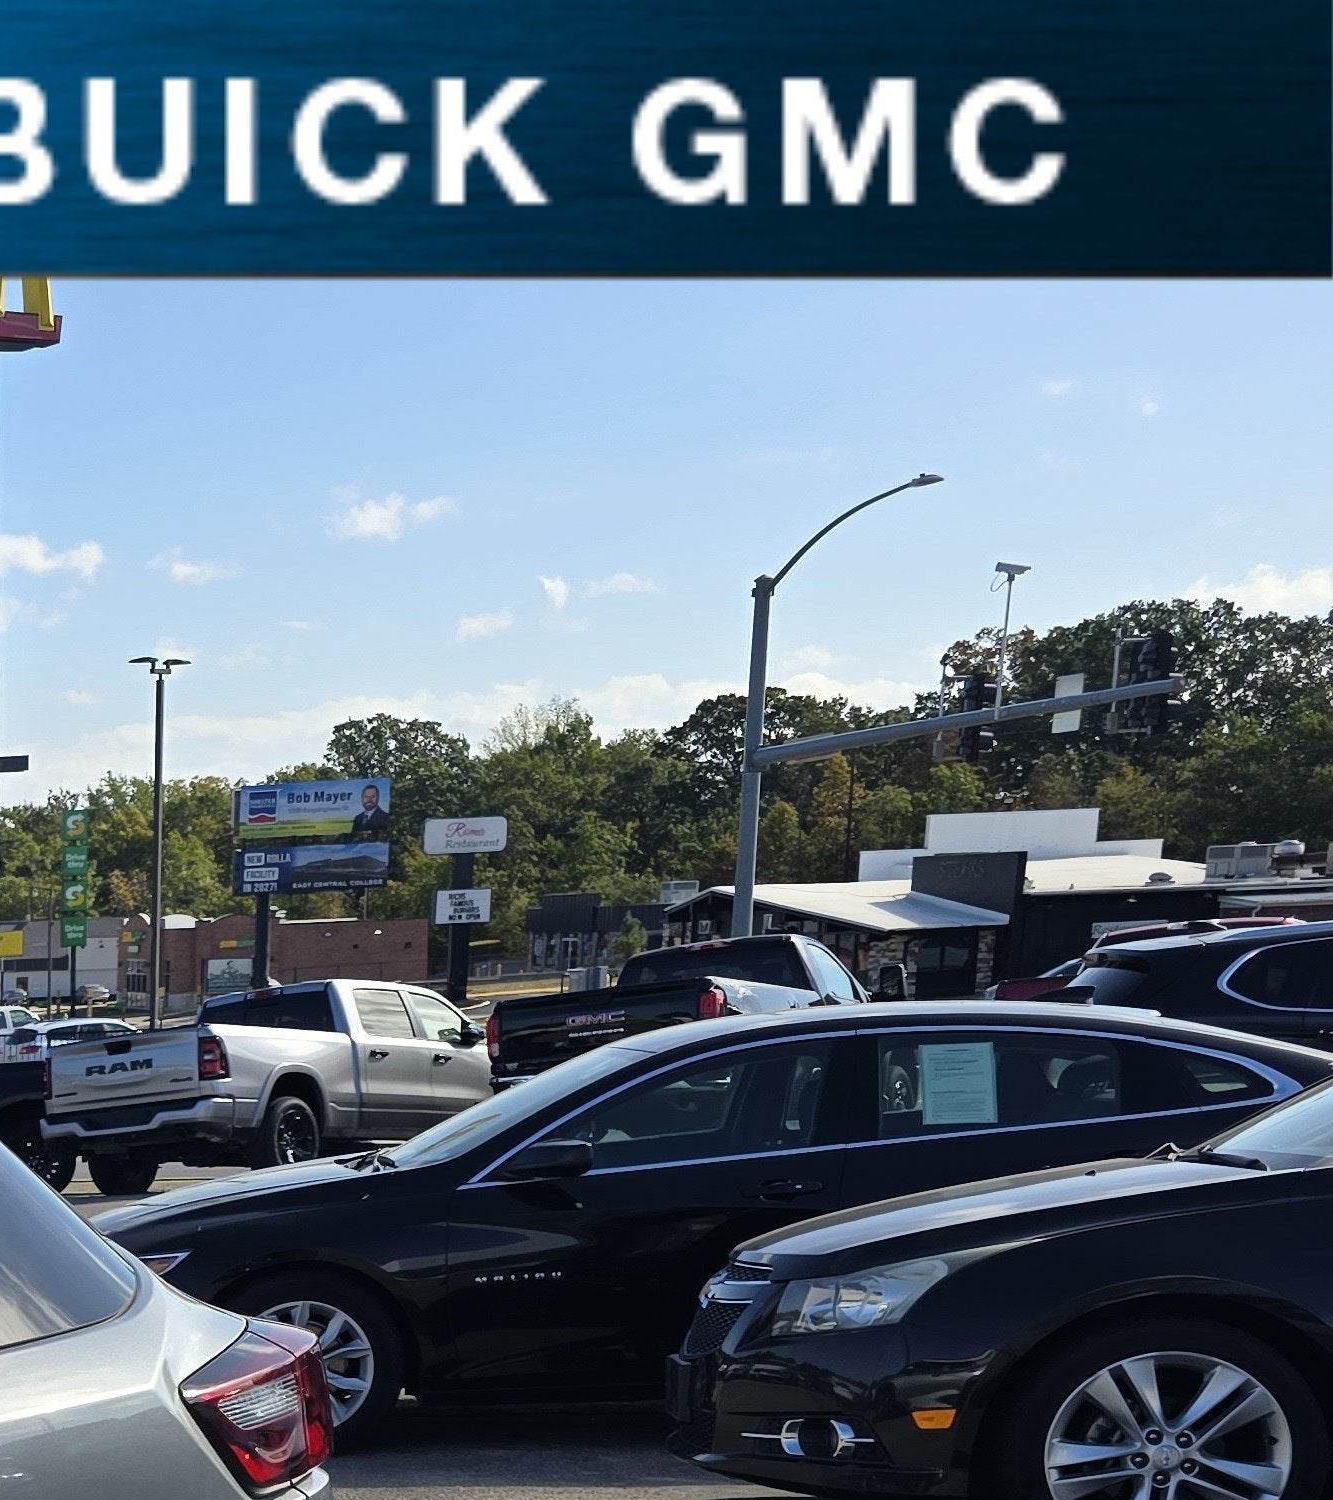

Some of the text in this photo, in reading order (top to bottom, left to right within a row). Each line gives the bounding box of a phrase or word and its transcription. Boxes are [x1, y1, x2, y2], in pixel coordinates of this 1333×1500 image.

[287, 791, 353, 805] Bob Mayer
[445, 838, 500, 849] Restaurant
[65, 853, 87, 862] Drive
[246, 853, 291, 864] NEW ROLLA
[246, 870, 276, 879] FACILITY
[292, 878, 384, 889] EAST CENTRAL COLLEGE
[64, 924, 85, 933] Drive
[566, 1010, 626, 1029] GMC
[85, 1058, 153, 1077] RAM
